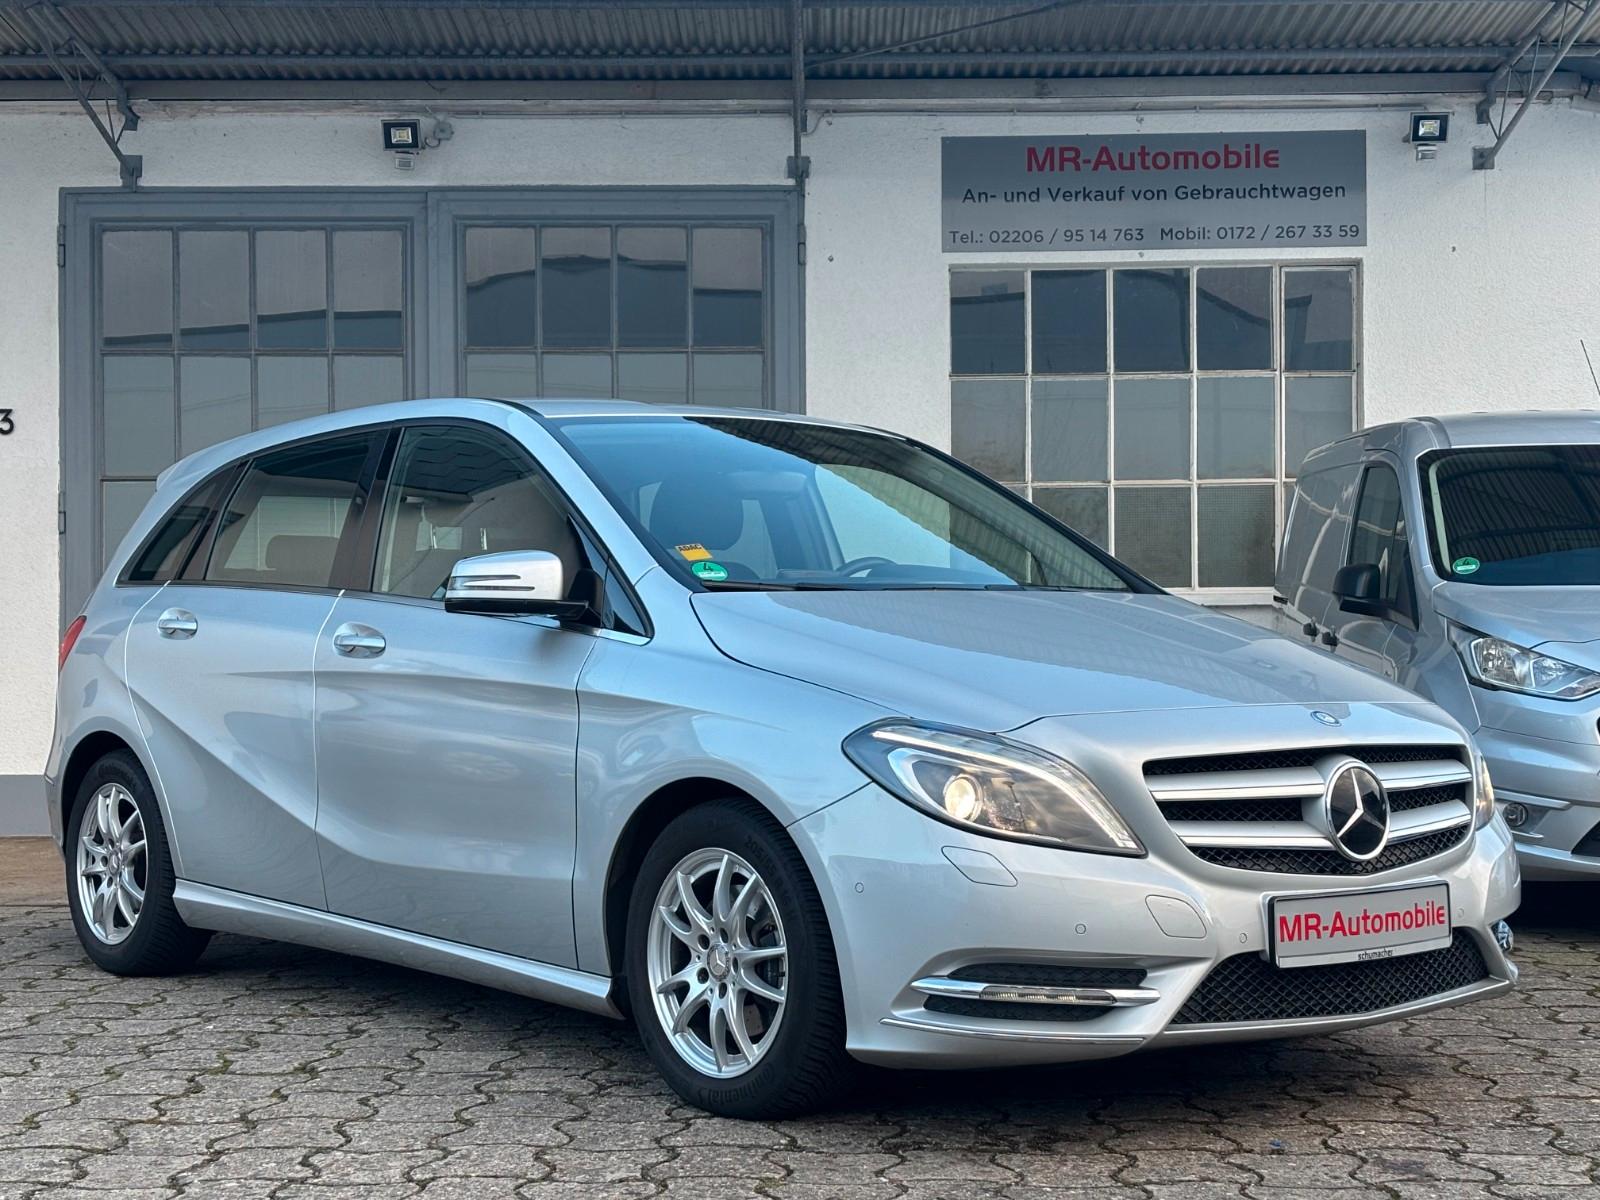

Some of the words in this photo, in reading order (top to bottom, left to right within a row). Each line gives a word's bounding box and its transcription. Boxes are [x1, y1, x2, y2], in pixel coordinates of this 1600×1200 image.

[1026, 144, 1280, 172] MR-Automobile
[962, 188, 997, 203] An-
[1004, 188, 1040, 202] und
[1048, 186, 1125, 202] Verkauf
[1131, 189, 1167, 201] von
[1175, 184, 1346, 201] Gebrauchtwagen
[949, 230, 983, 243] Tel.:
[989, 230, 1044, 243] 02206
[1049, 228, 1058, 244] /
[1064, 229, 1084, 242] 95
[1090, 229, 1107, 241] 14
[1113, 228, 1144, 241] 763
[1160, 227, 1210, 241] Mobil:
[1217, 226, 1255, 239] 0172
[1260, 224, 1270, 241] /
[1275, 225, 1306, 238] 267
[1312, 225, 1333, 238] 33
[1339, 224, 1360, 238] 59
[1279, 901, 1445, 942] MR-Automobile
